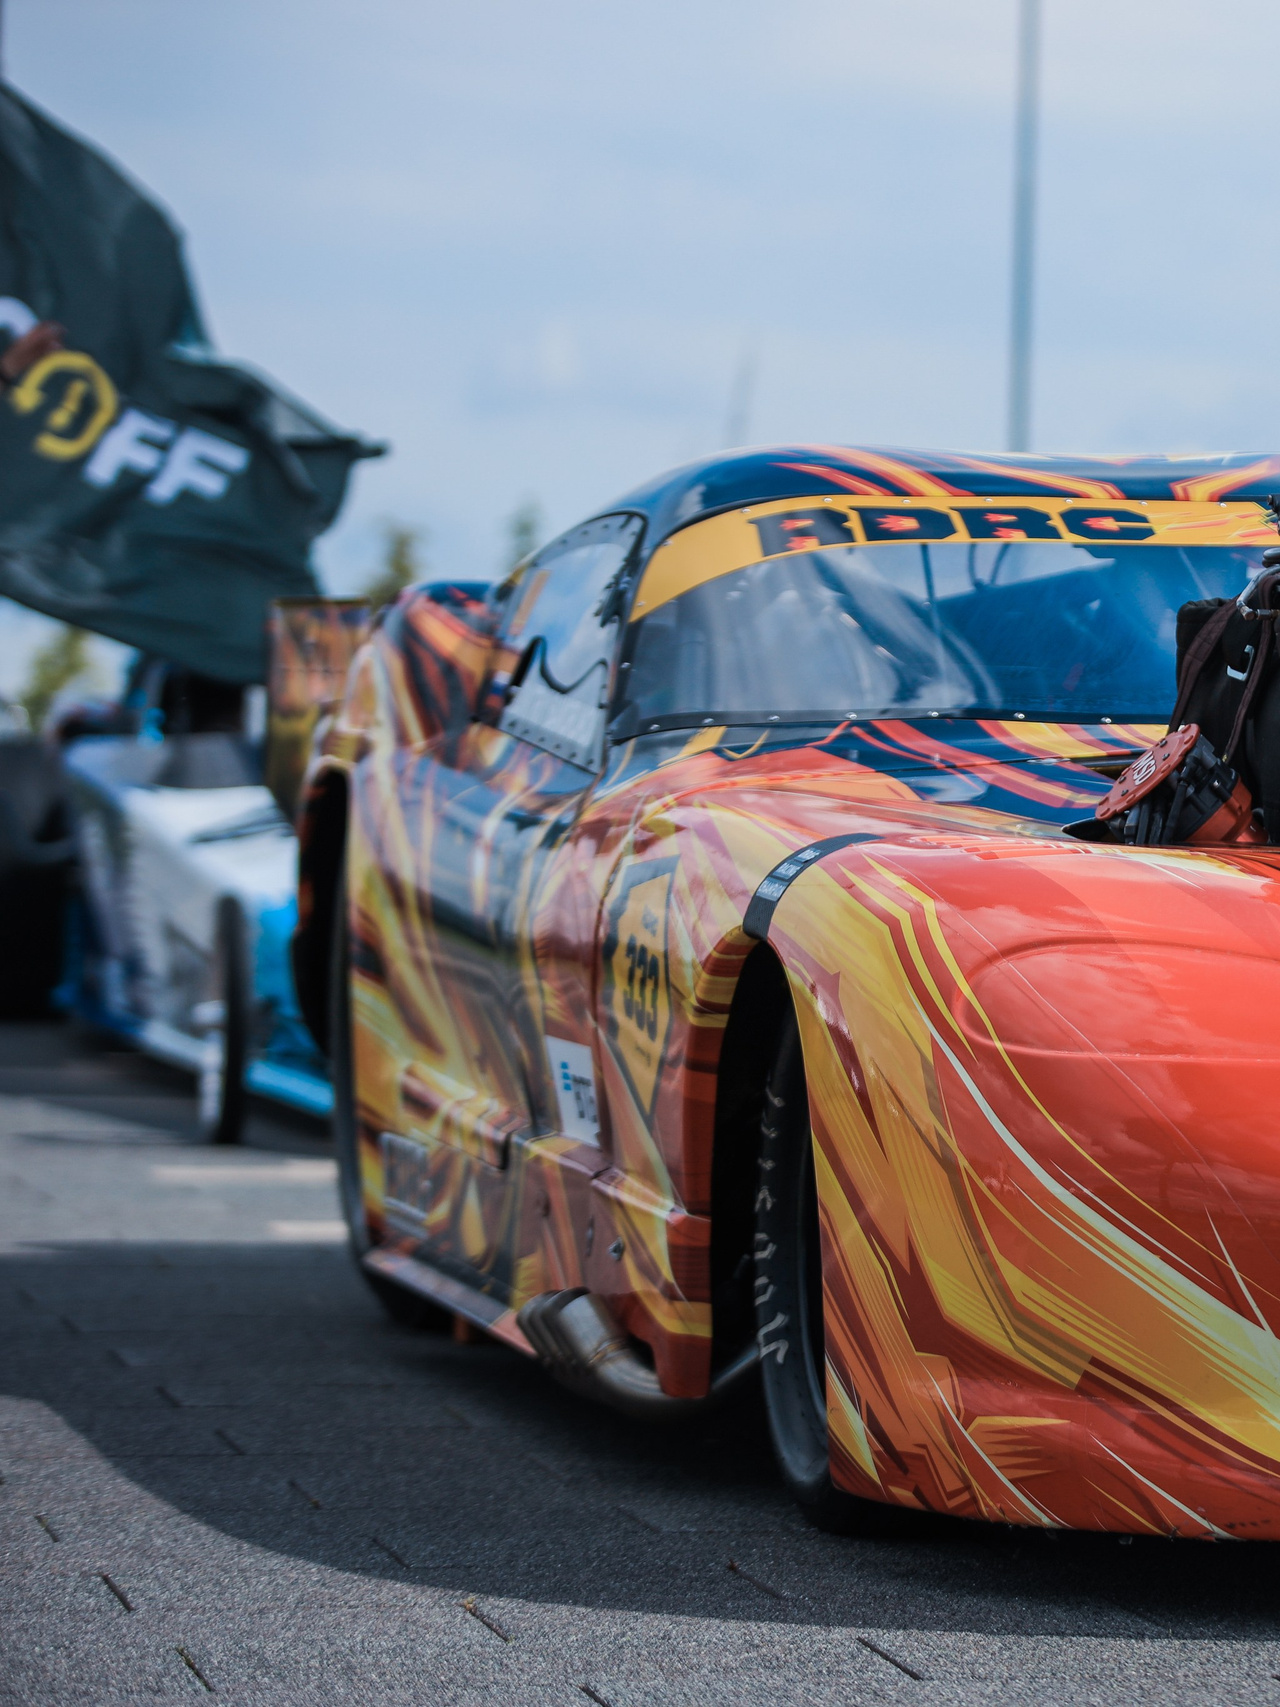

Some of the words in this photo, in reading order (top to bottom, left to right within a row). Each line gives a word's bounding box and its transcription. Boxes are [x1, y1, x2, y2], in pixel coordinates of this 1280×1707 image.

[747, 505, 1157, 558] RDRC
[1131, 750, 1156, 786] MSD
[623, 933, 660, 1043] 333
